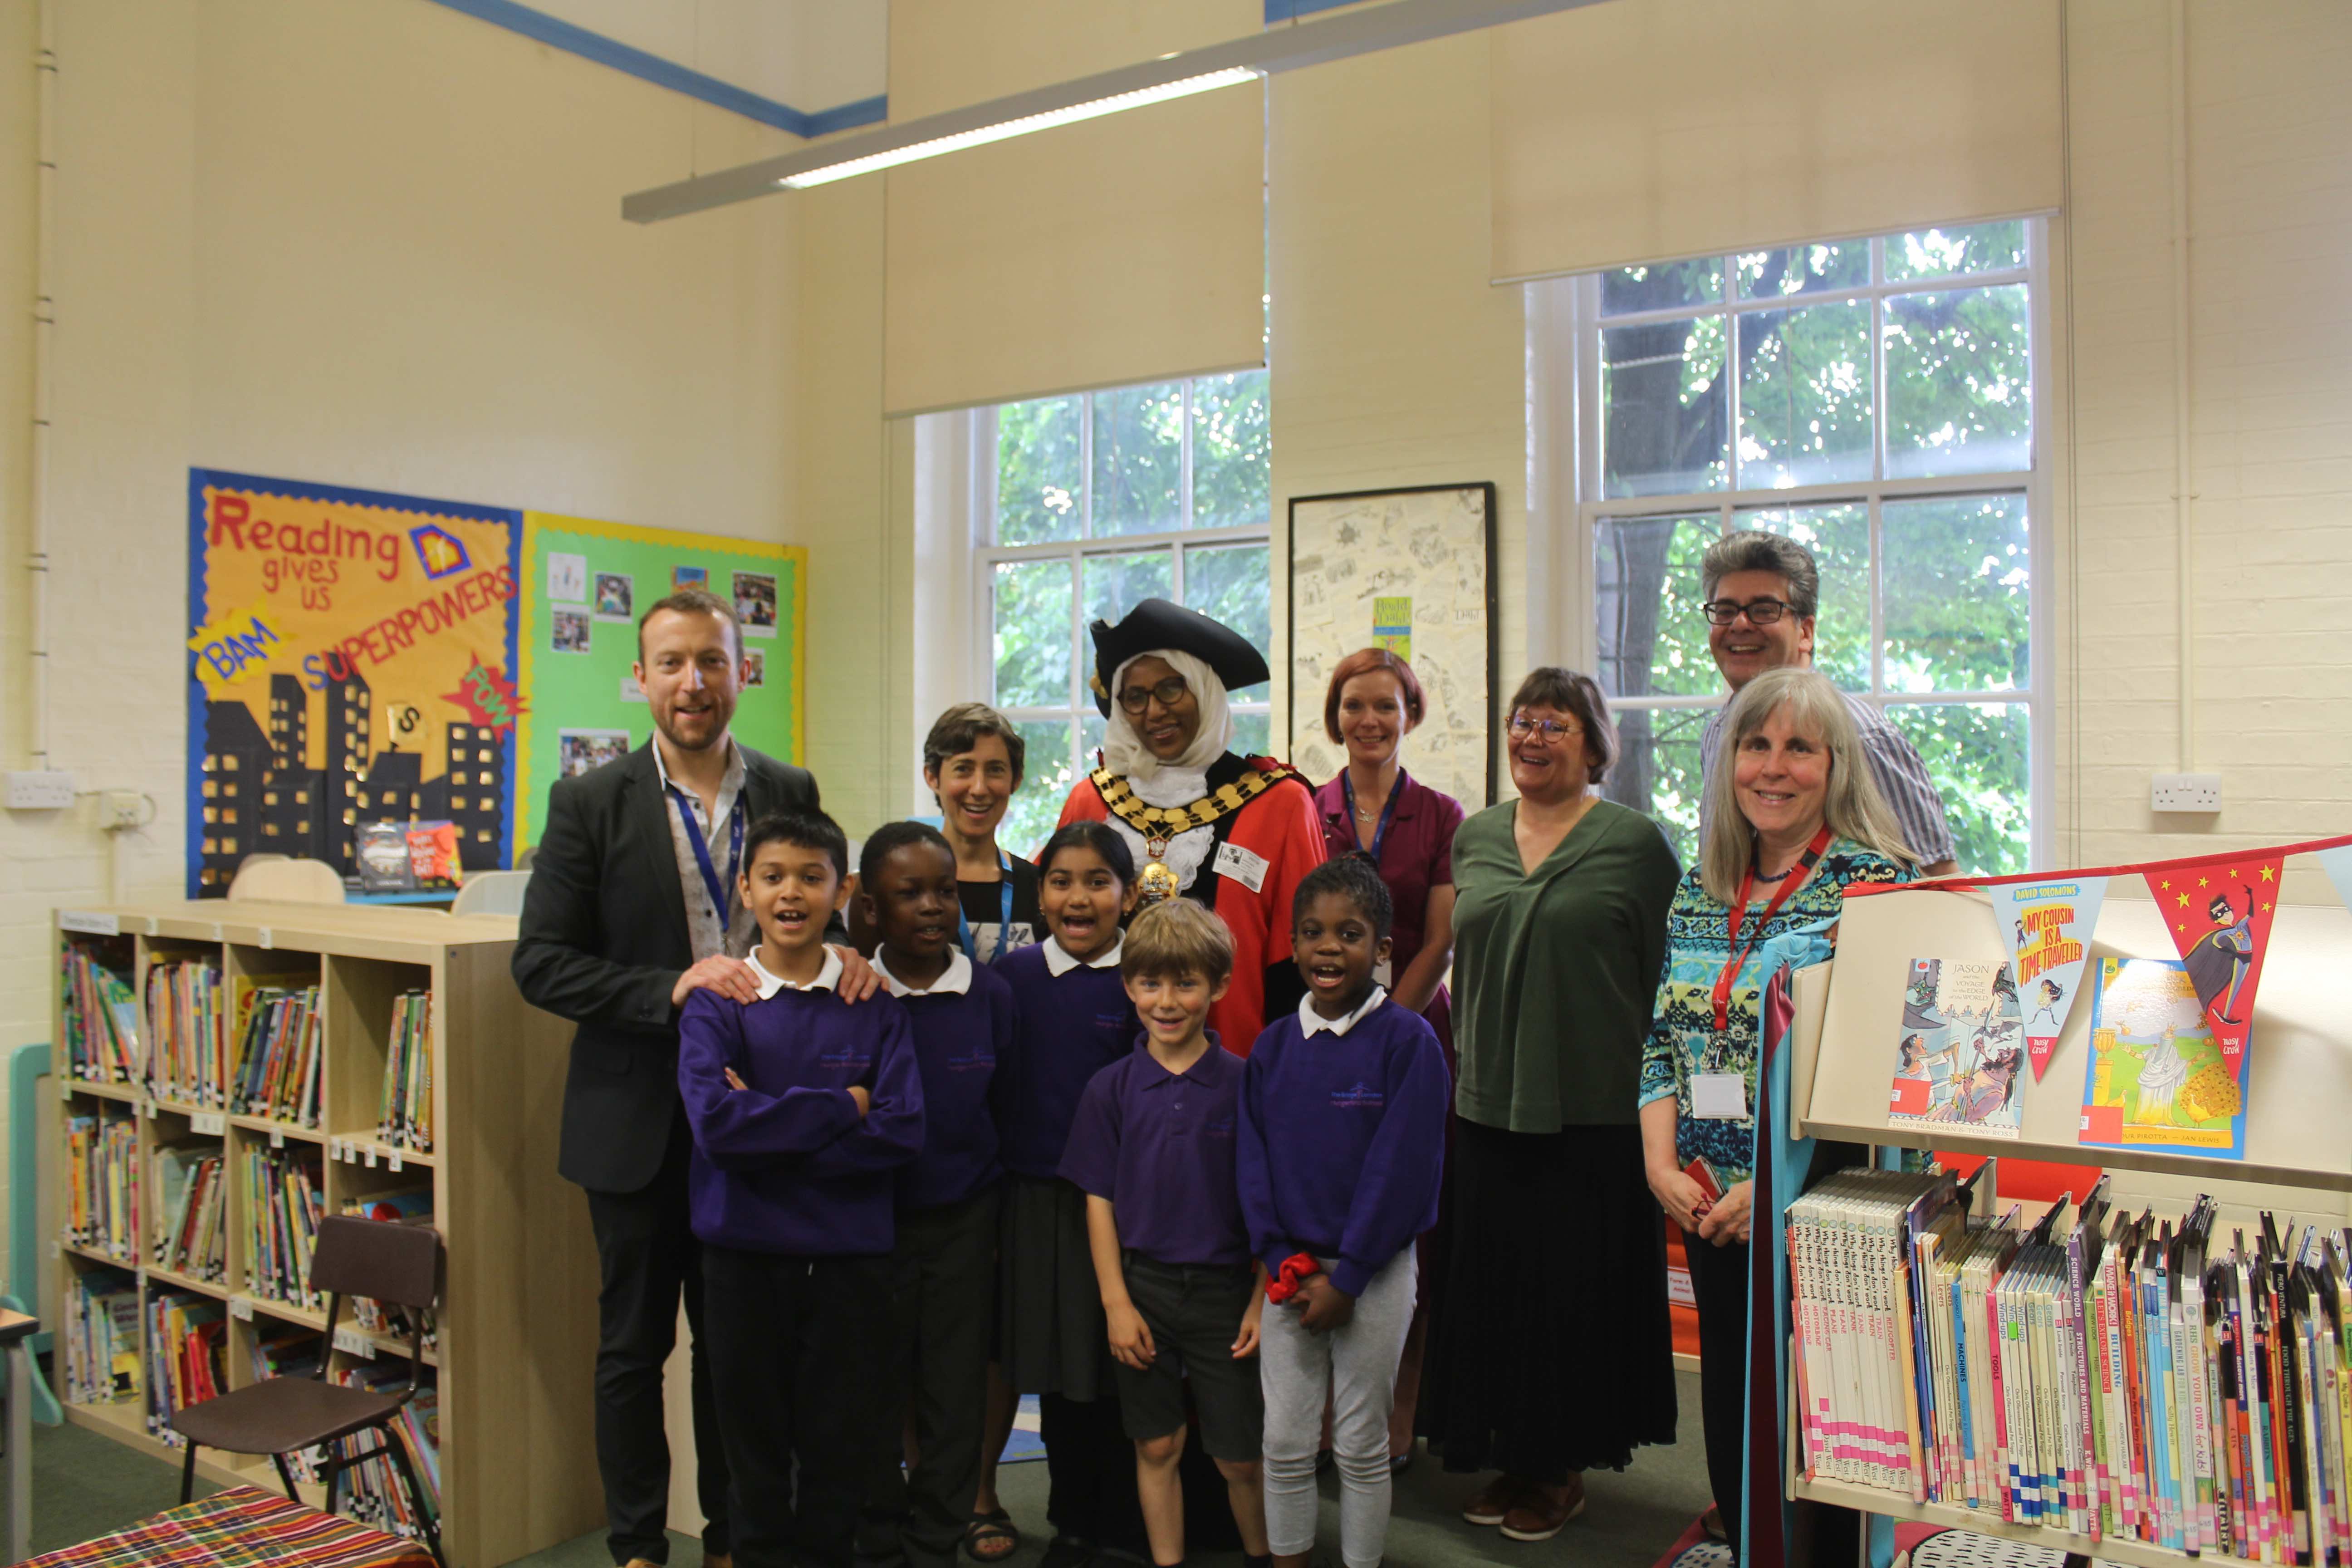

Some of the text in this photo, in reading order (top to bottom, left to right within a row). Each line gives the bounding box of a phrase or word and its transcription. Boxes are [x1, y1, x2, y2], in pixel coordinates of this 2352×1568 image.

[211, 495, 400, 581] Reading
[263, 556, 339, 593] gives
[302, 586, 331, 611] us
[303, 566, 518, 691] SUPERPOWERS
[201, 617, 281, 680] BAM
[465, 664, 512, 726] POW
[2015, 885, 2077, 901] DAVID SOLOMONS
[2026, 908, 2074, 936] MY COUSIN
[2045, 926, 2062, 946] IS A
[1952, 964, 1989, 975] JASON
[2020, 942, 2083, 988] TIME TRAVELLER
[2034, 1039, 2049, 1049] nosy
[2222, 1037, 2239, 1048] nosy
[1916, 1123, 1956, 1132] BRADMAN
[1937, 1284, 1945, 1307] Levers
[1803, 1304, 1811, 1345] MOTORBIKE
[1813, 1305, 1821, 1346] MOTORBIKE
[1886, 1318, 1895, 1361] HELICOPTER
[2018, 1306, 2026, 1343] Wind-ups
[2099, 1323, 2107, 1357] EXPLORE
[2189, 1325, 2197, 1343] RHS
[2071, 1257, 2079, 1288] SCIENCE
[2076, 1332, 2085, 1376] STRUCTURES
[2081, 1396, 2089, 1434] MATERIALS
[2111, 1334, 2122, 1387] BUILDING
[2174, 1331, 2183, 1362] GARDENING
[2191, 1346, 2200, 1374] GROW
[1957, 1343, 1966, 1382] MACHINES
[2102, 1359, 2110, 1392] SCIENCE
[2193, 1377, 2201, 1402] YOUR
[2195, 1406, 2203, 1430] OWN
[2195, 1434, 2204, 1448] for
[2240, 1434, 2252, 1467] puppies
